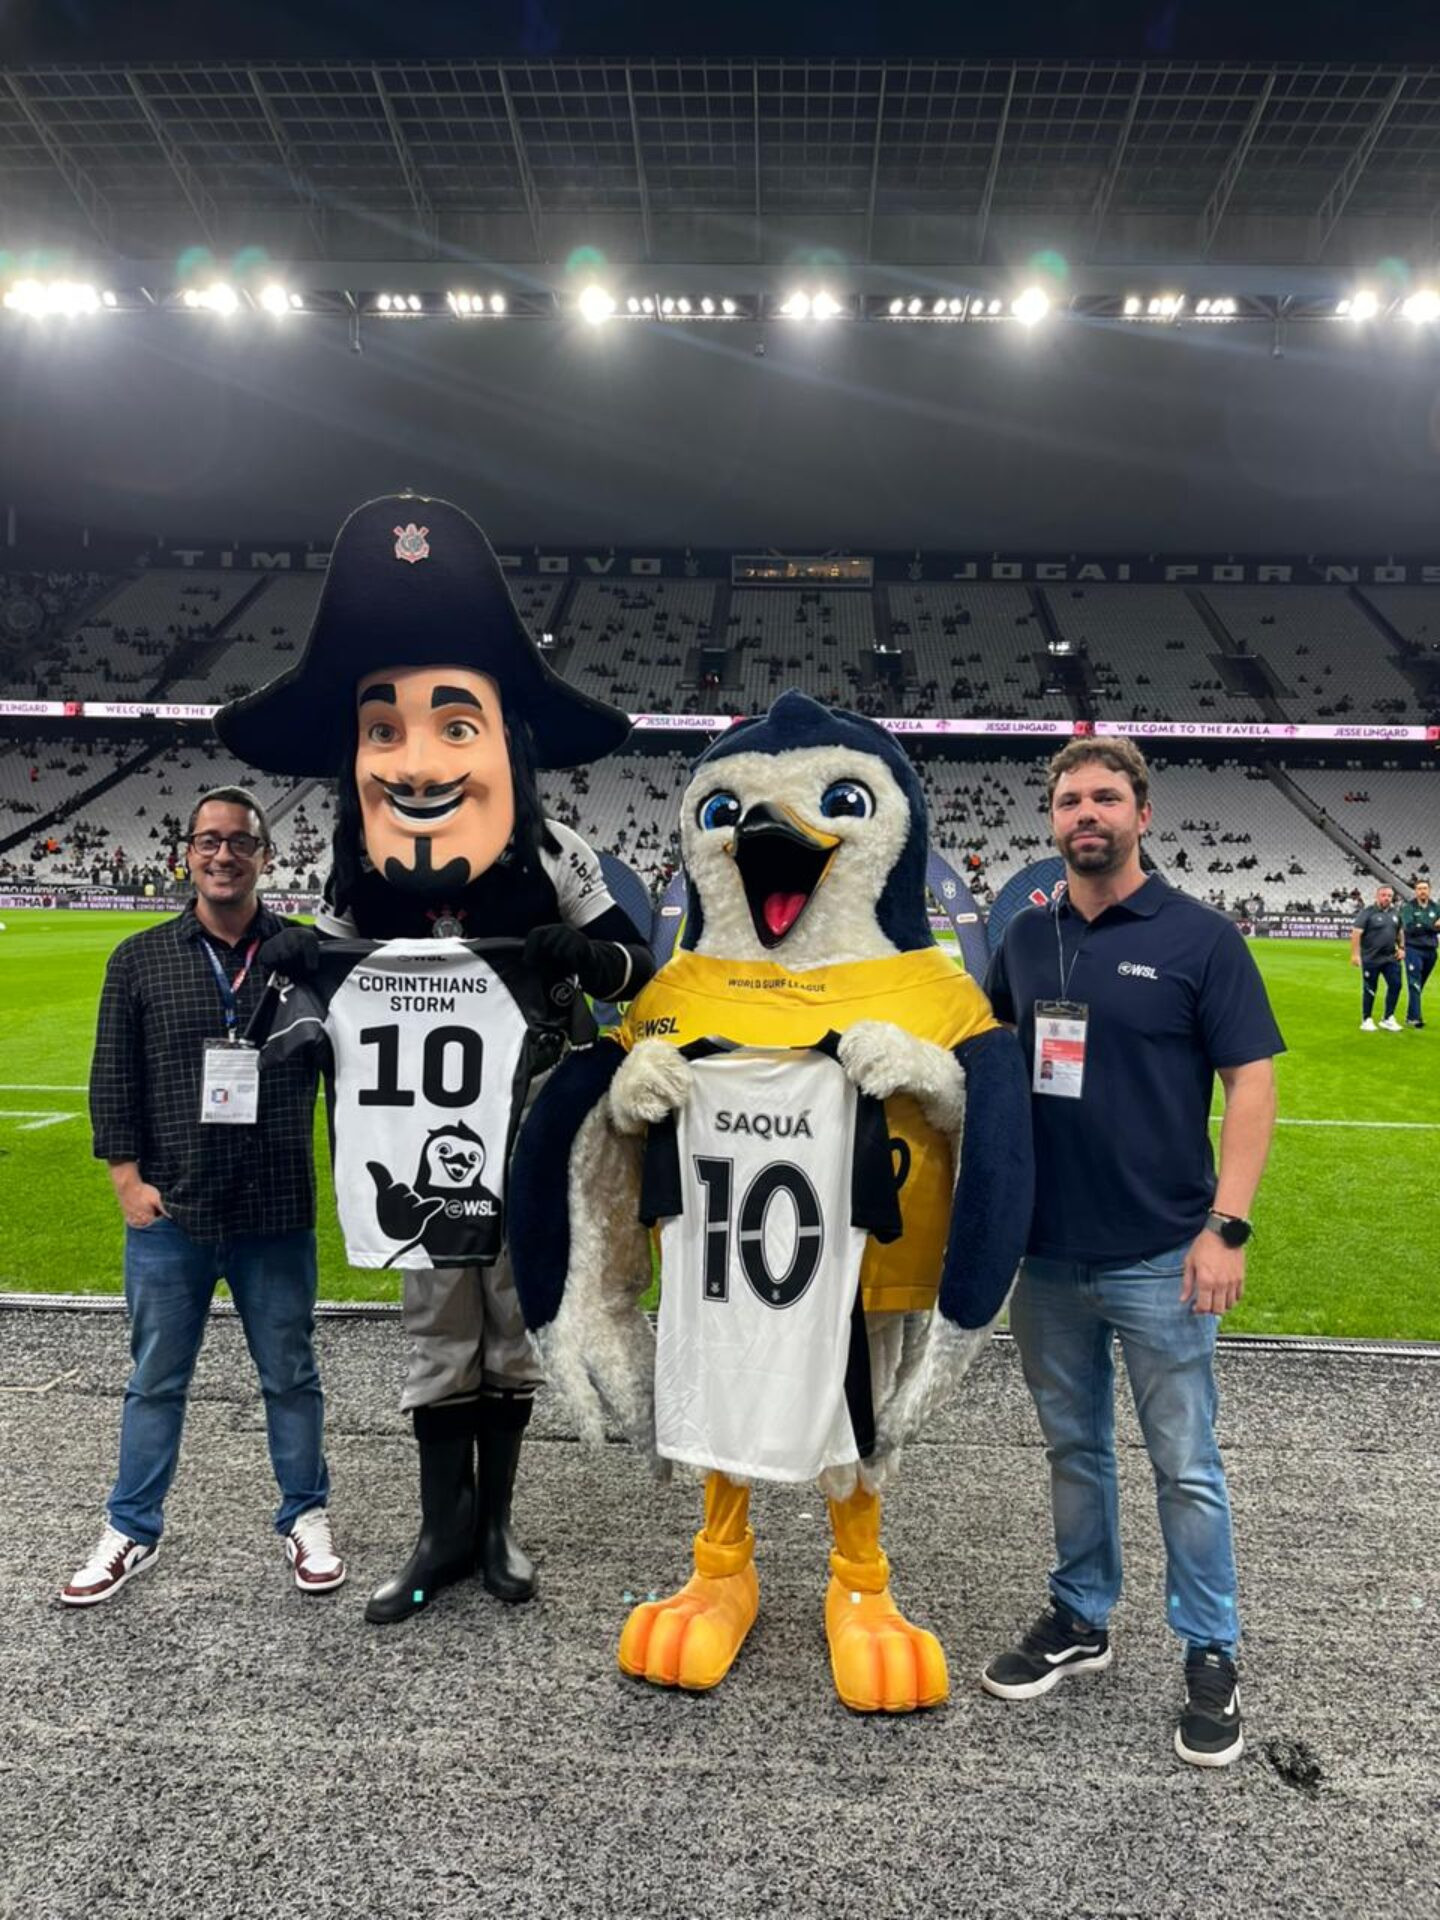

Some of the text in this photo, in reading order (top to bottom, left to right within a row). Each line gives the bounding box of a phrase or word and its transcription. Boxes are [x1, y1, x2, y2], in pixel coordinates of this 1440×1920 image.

[172, 550, 332, 570] TIME
[953, 562, 1131, 580] JOGAI
[1165, 565, 1292, 582] POR
[6, 703, 48, 713] LINGARD
[106, 705, 160, 715] WELCOME
[165, 706, 181, 715] TO
[185, 707, 205, 716] THE
[646, 717, 715, 727] JESSE LINGARD
[985, 722, 1057, 732] JESSE LINGARD
[1117, 723, 1270, 735] WELCOME TO THE FAVELA
[1334, 727, 1409, 738] JESSE LINGARD
[1131, 963, 1159, 980] WSL
[358, 975, 488, 994] CORINTHIANS
[728, 978, 761, 989] WORLD
[762, 978, 787, 989] SURF
[390, 995, 456, 1013] STORM
[645, 1015, 680, 1037] WSL
[358, 1023, 484, 1108] 10
[715, 1109, 814, 1140] SAQUÁ
[464, 1200, 498, 1217] WSL
[692, 1154, 825, 1310] 10
